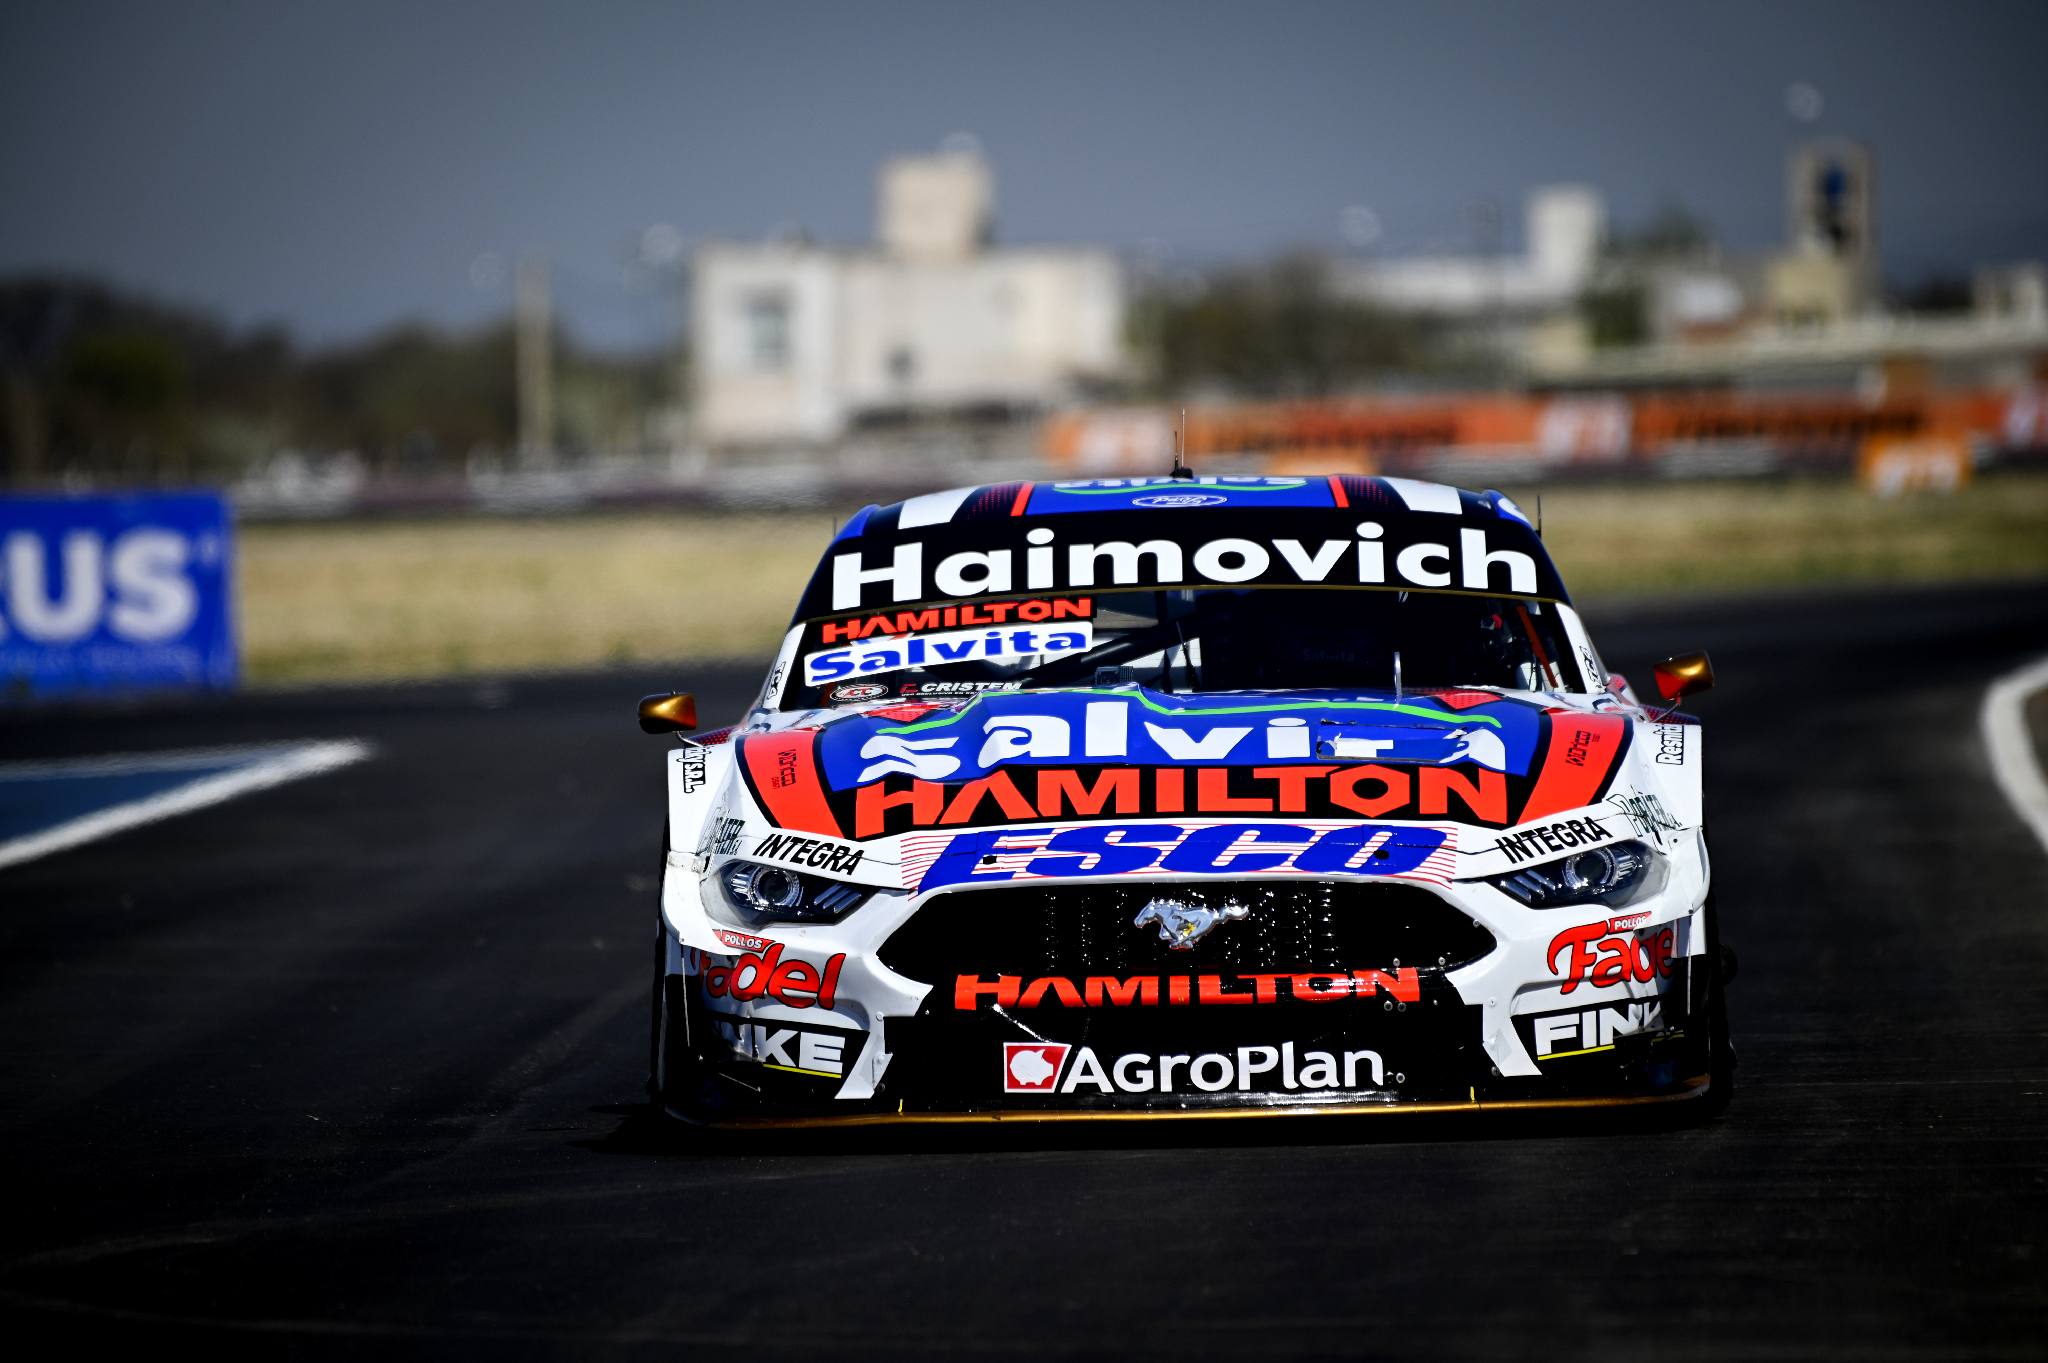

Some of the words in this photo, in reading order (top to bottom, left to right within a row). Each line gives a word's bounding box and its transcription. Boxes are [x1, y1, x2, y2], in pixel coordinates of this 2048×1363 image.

[0, 529, 198, 644] US
[831, 522, 1538, 612] Haimovich
[822, 598, 1093, 644] HAMILTON
[810, 626, 1088, 682] Salvita
[855, 764, 1508, 839] HAMILTON
[753, 833, 864, 877] INTEGRA
[916, 822, 1452, 893] ESCO
[1496, 815, 1614, 866] INTEGRA
[724, 934, 763, 949] POLLOS
[955, 967, 1421, 1012] HAMILTON
[1061, 1040, 1385, 1094] AgroPlan
